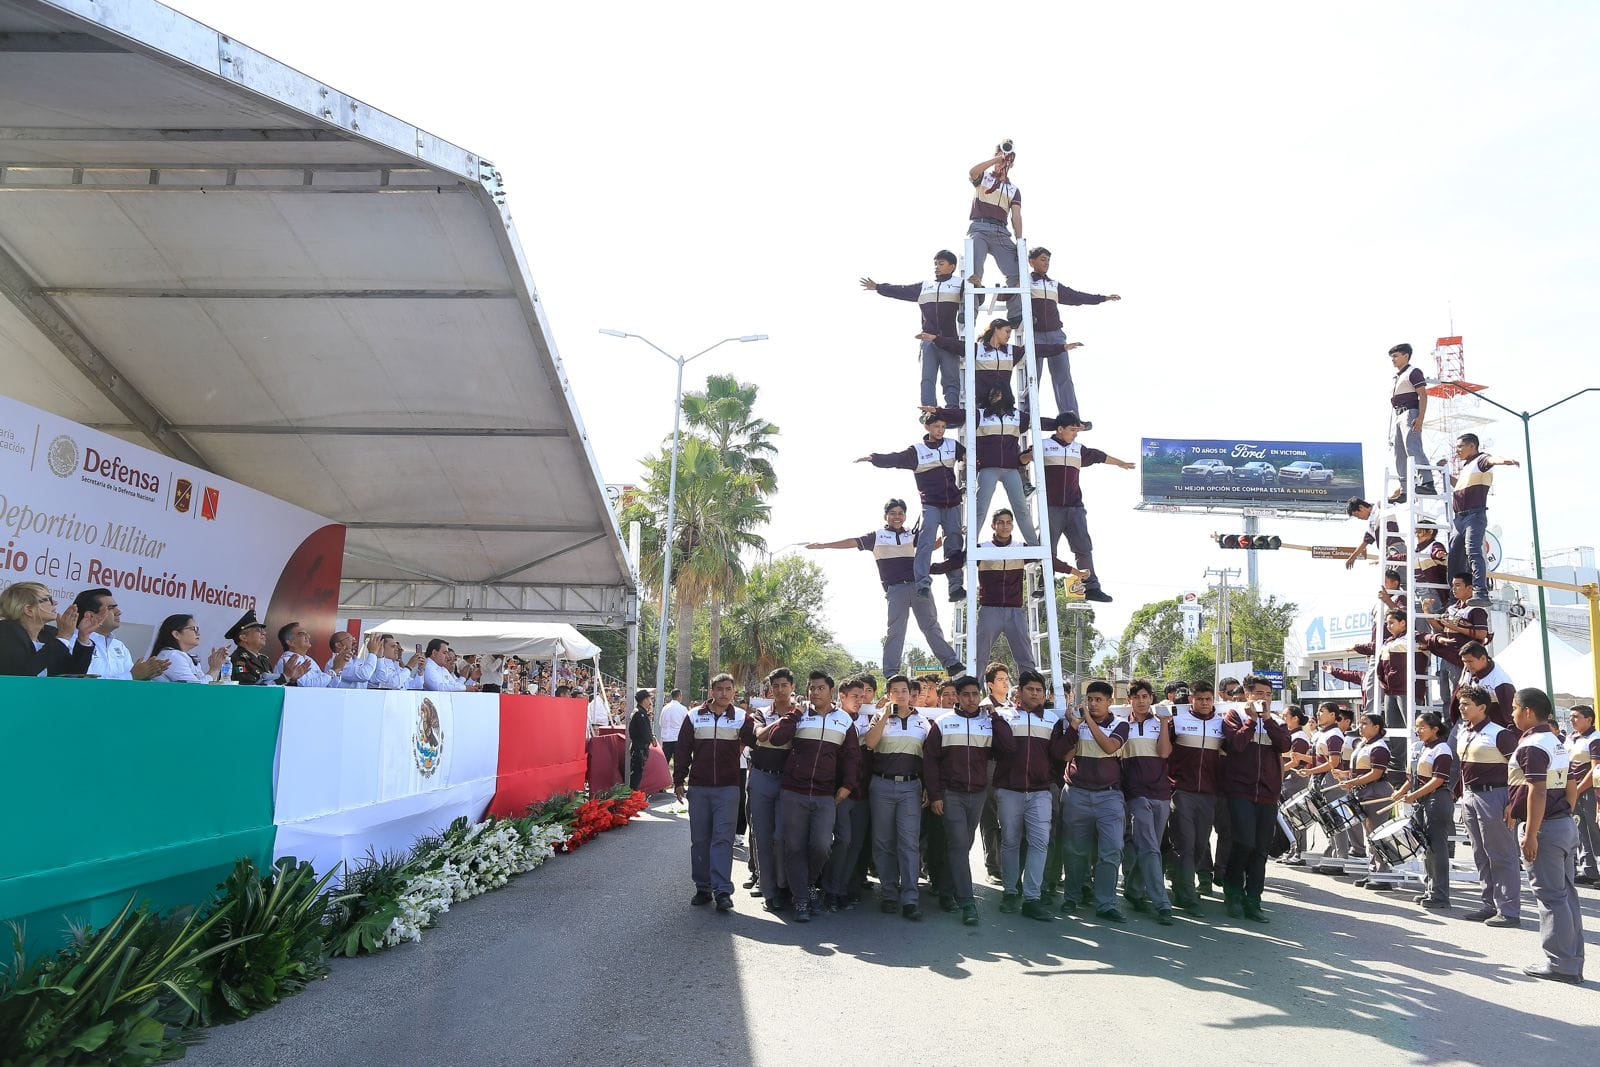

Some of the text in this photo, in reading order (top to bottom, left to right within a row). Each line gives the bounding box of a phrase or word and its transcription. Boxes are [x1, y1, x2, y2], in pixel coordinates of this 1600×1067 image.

[1191, 446, 1200, 454] 70
[1231, 443, 1267, 459] Ford
[83, 447, 160, 494] Defensa
[106, 483, 112, 491] de
[118, 486, 136, 498] Defensa
[136, 491, 156, 503] Nacional
[100, 521, 167, 560] Militar
[34, 547, 60, 578] de
[65, 552, 82, 582] la
[87, 558, 187, 600] Revolución
[190, 579, 257, 610] Mexicana
[1329, 616, 1342, 632] EL
